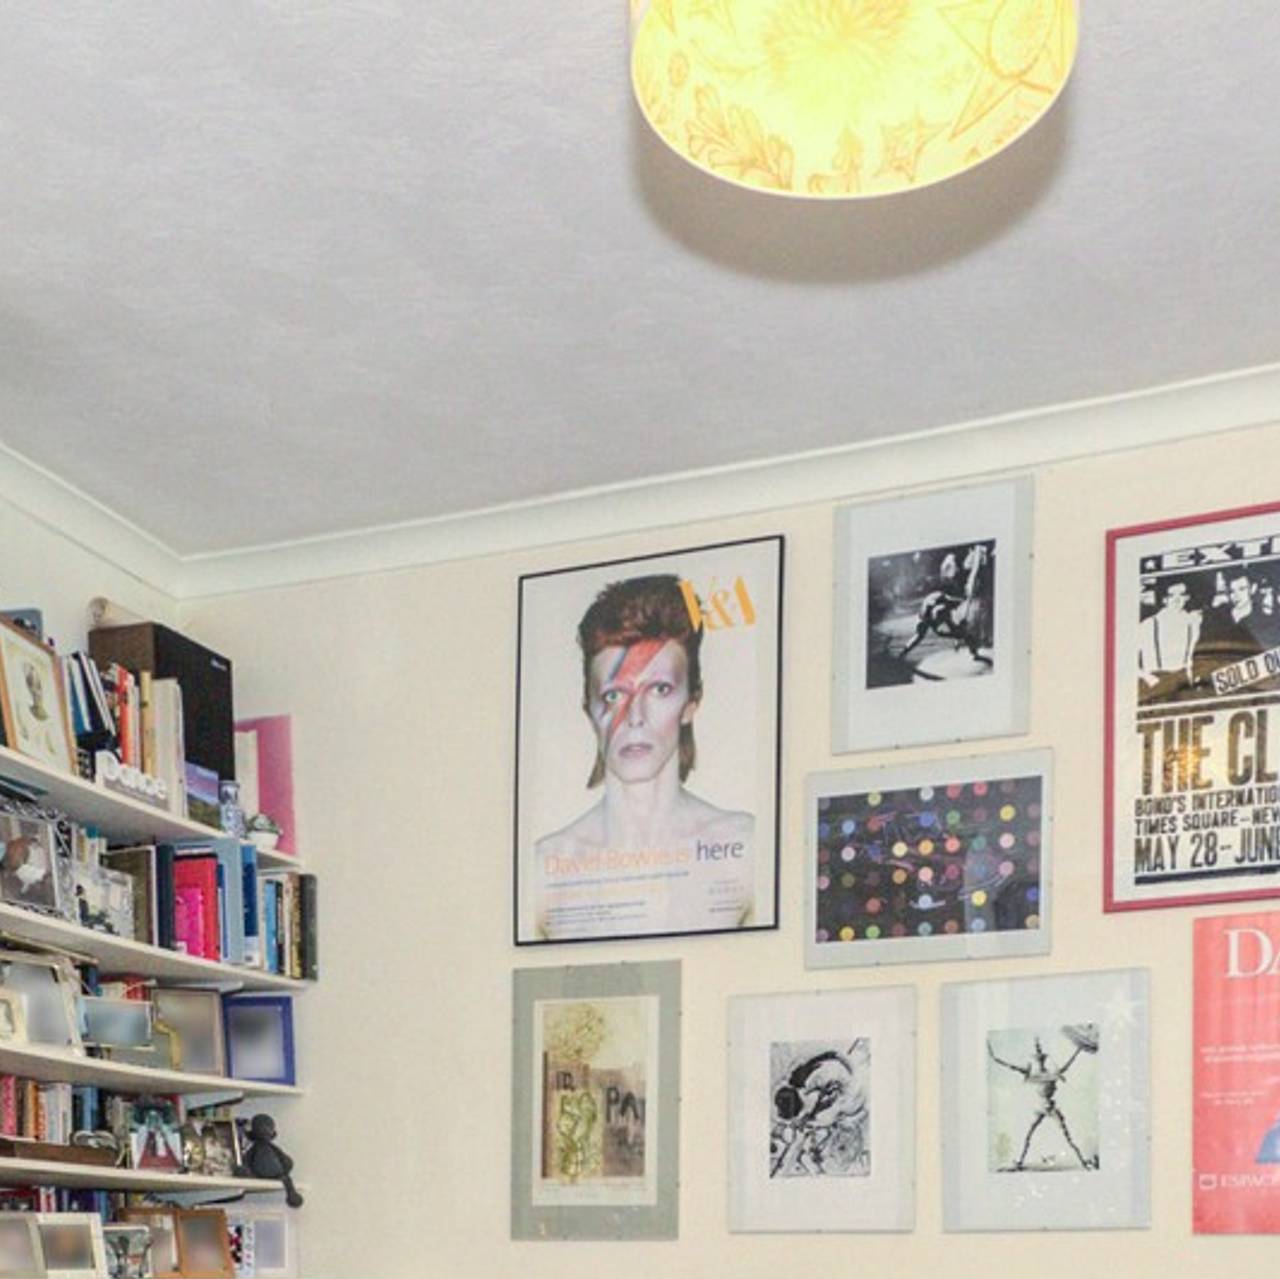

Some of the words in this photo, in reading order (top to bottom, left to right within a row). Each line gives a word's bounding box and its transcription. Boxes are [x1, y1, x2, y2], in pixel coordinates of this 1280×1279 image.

[678, 576, 757, 632] V&A
[1216, 660, 1258, 692] SOLD
[1137, 715, 1214, 795] THE
[1135, 814, 1177, 836] TIMES
[696, 839, 744, 861] here
[1134, 835, 1179, 872] MAY
